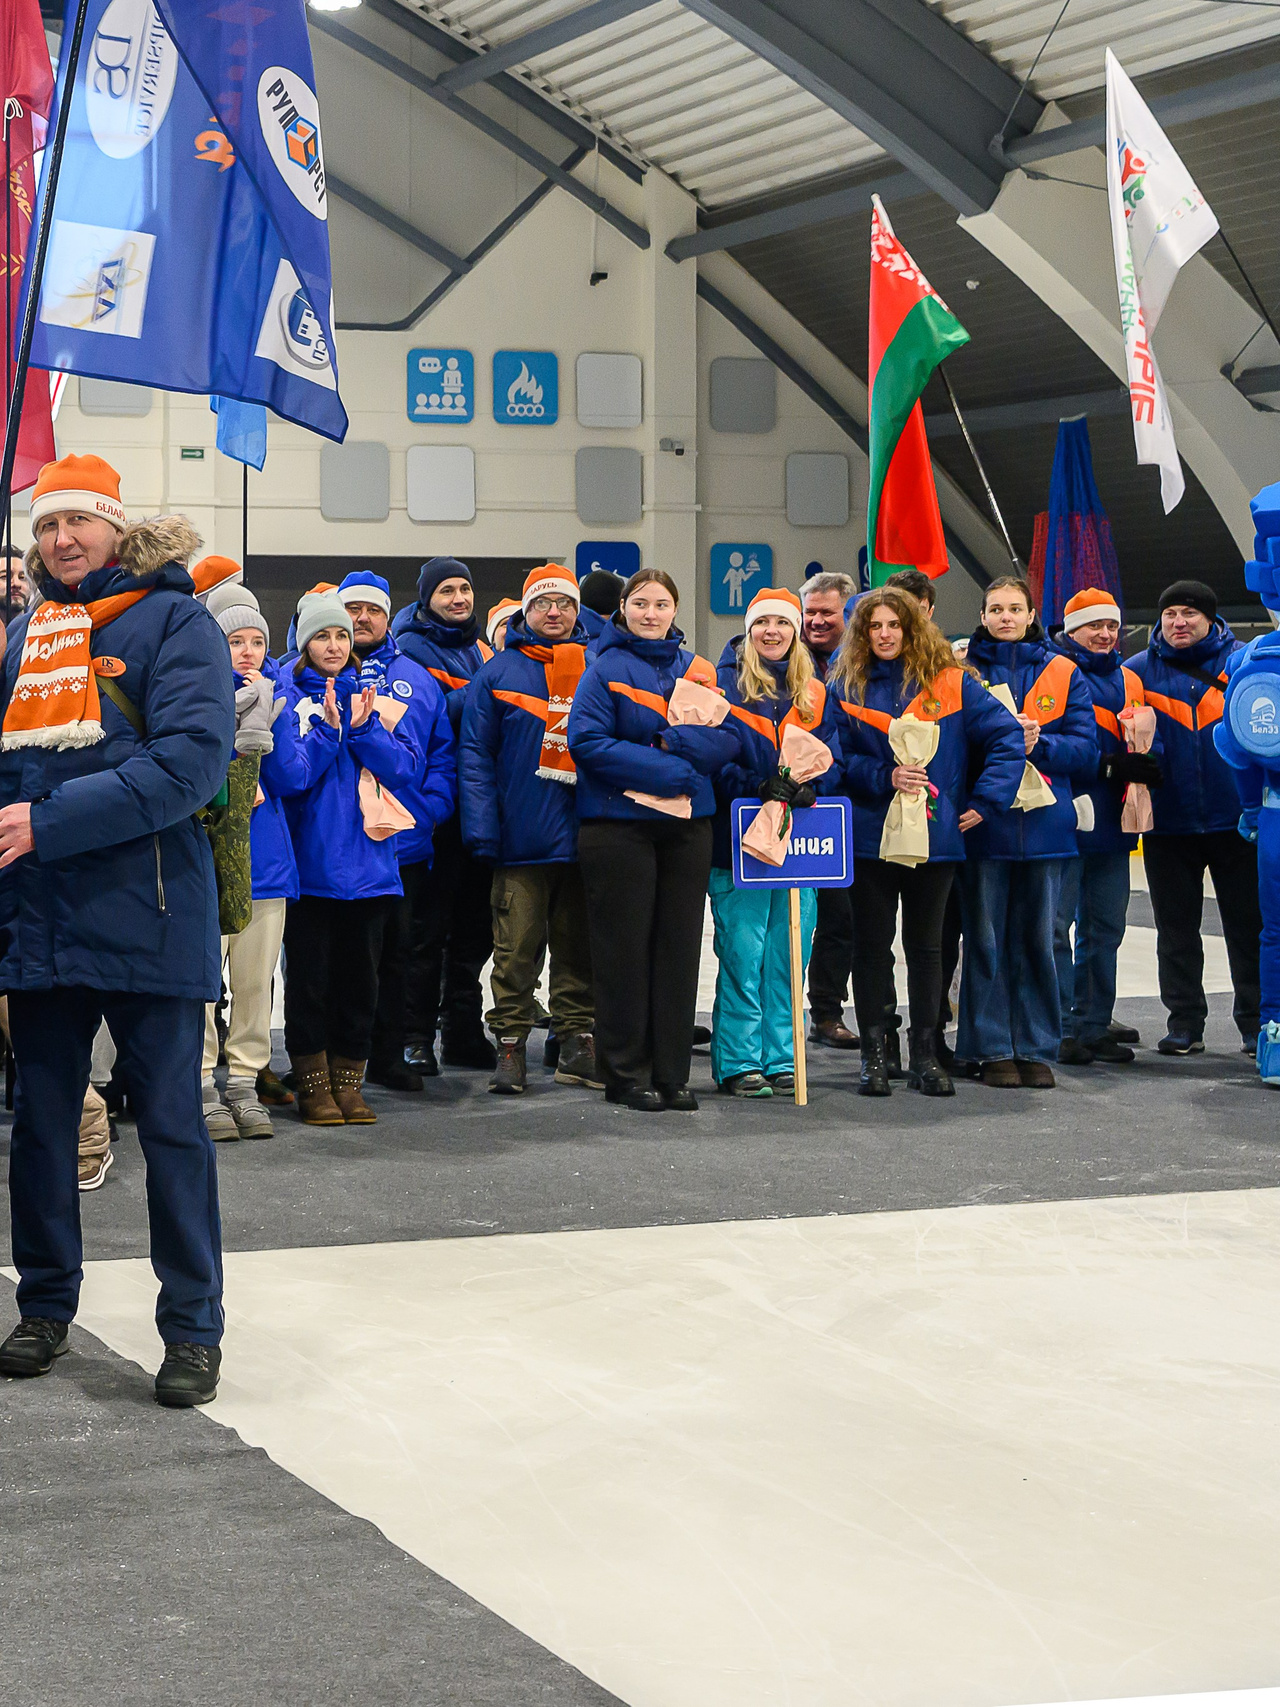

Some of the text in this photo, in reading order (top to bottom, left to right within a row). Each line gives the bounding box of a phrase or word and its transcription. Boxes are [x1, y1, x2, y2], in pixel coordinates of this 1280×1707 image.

[265, 78, 300, 130] РУП
[96, 501, 126, 522] БЕЛАР
[528, 581, 558, 598] АРУСЬ
[20, 632, 86, 668] Молния
[101, 657, 114, 669] DS
[786, 836, 835, 856] лния
